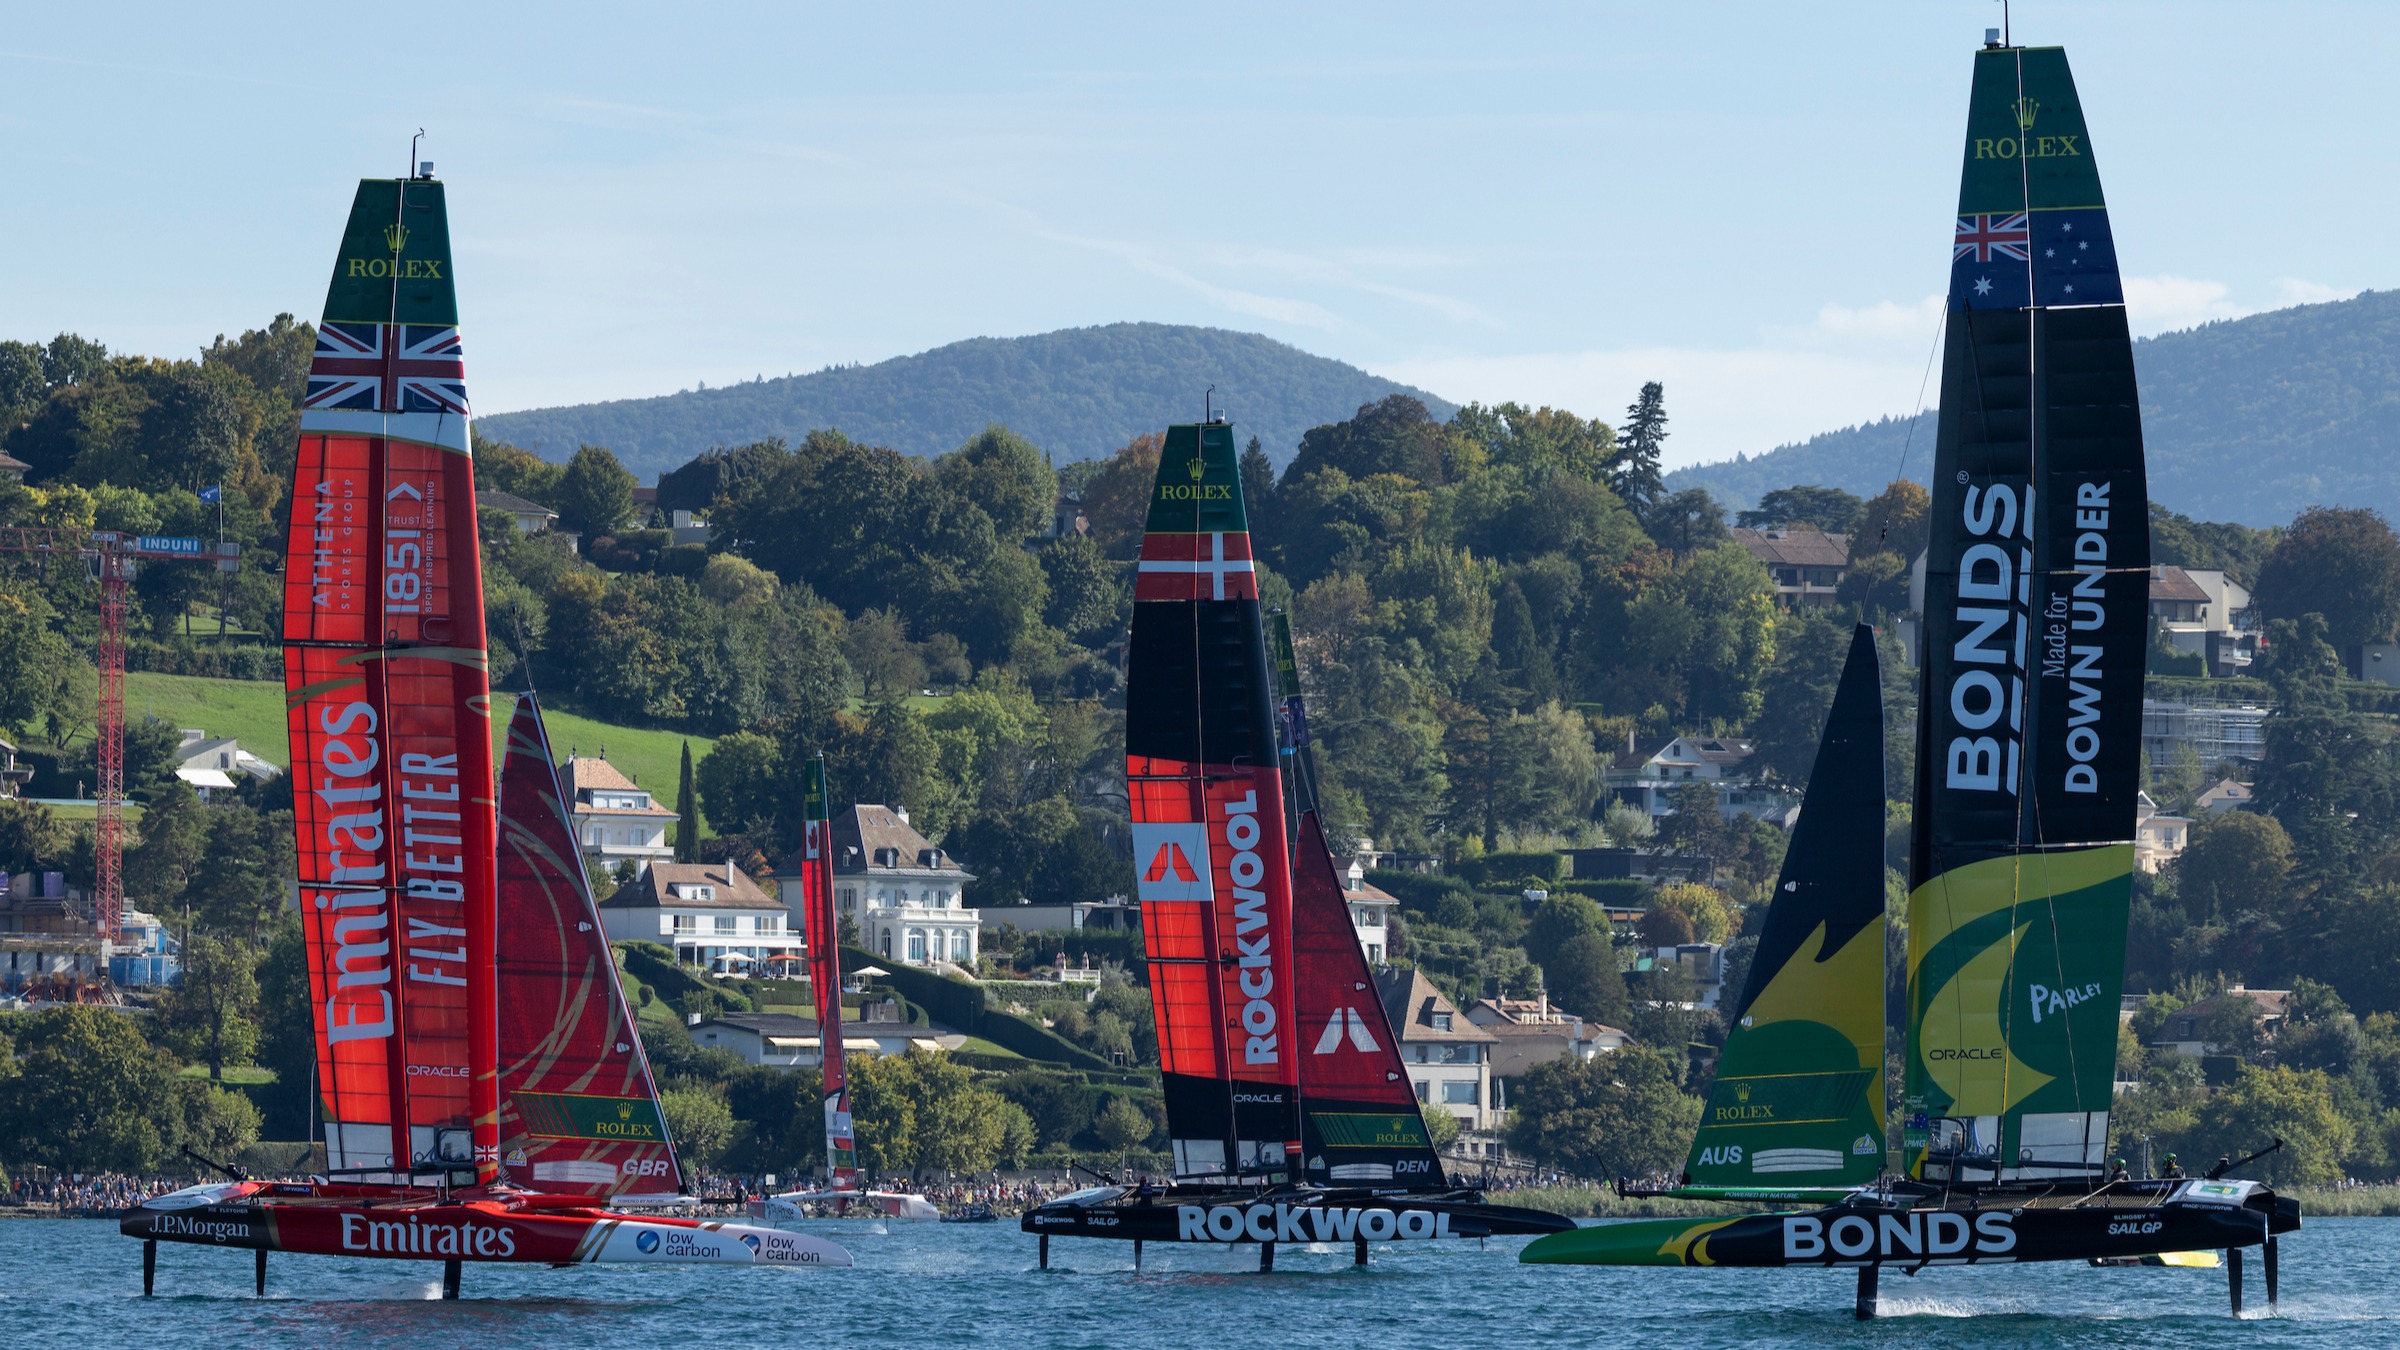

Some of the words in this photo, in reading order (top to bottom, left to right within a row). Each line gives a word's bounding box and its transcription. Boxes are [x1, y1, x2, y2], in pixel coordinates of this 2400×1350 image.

[1974, 135, 2081, 159] ROLEX
[347, 258, 443, 279] ROLEX
[1160, 484, 1232, 501] ROLEX
[343, 479, 353, 535] GROUP
[426, 481, 435, 530] LEARNING
[388, 516, 421, 525] TRUST
[145, 538, 198, 551] INDUNI
[312, 479, 335, 608] ATHENA
[425, 533, 434, 578] INSPIRED
[2070, 481, 2111, 631] UNDER
[341, 547, 352, 609] SPORTS
[425, 580, 433, 612] SPORT
[2043, 592, 2069, 620] for
[2042, 626, 2068, 679] Made
[2064, 645, 2104, 794] DOWN
[400, 752, 465, 902] BETTER
[313, 700, 395, 1047] Emirates
[1224, 789, 1279, 1065] ROCKWOOL
[408, 917, 468, 988] FLY
[2029, 982, 2102, 1024] PARLEY
[1929, 1048, 2003, 1061] ORACLE
[406, 1065, 470, 1078] ORACLE
[1233, 1093, 1283, 1103] ORACLE
[1716, 1105, 1775, 1120] ROLEX
[596, 1121, 654, 1137] ROLEX
[1375, 1133, 1419, 1143] ROLEX
[1395, 1160, 1430, 1173] DEN
[1697, 1145, 1743, 1166] AUS
[622, 1159, 669, 1177] GBR
[1724, 1191, 1758, 1199] POWERED
[148, 1214, 251, 1242] J.P.Morgan
[1177, 1203, 1460, 1242] ROCKWOOL
[340, 1213, 516, 1258] Emirates
[665, 1230, 695, 1245] low
[766, 1234, 795, 1249] low
[665, 1244, 721, 1259] carbon
[766, 1248, 821, 1263] carbon
